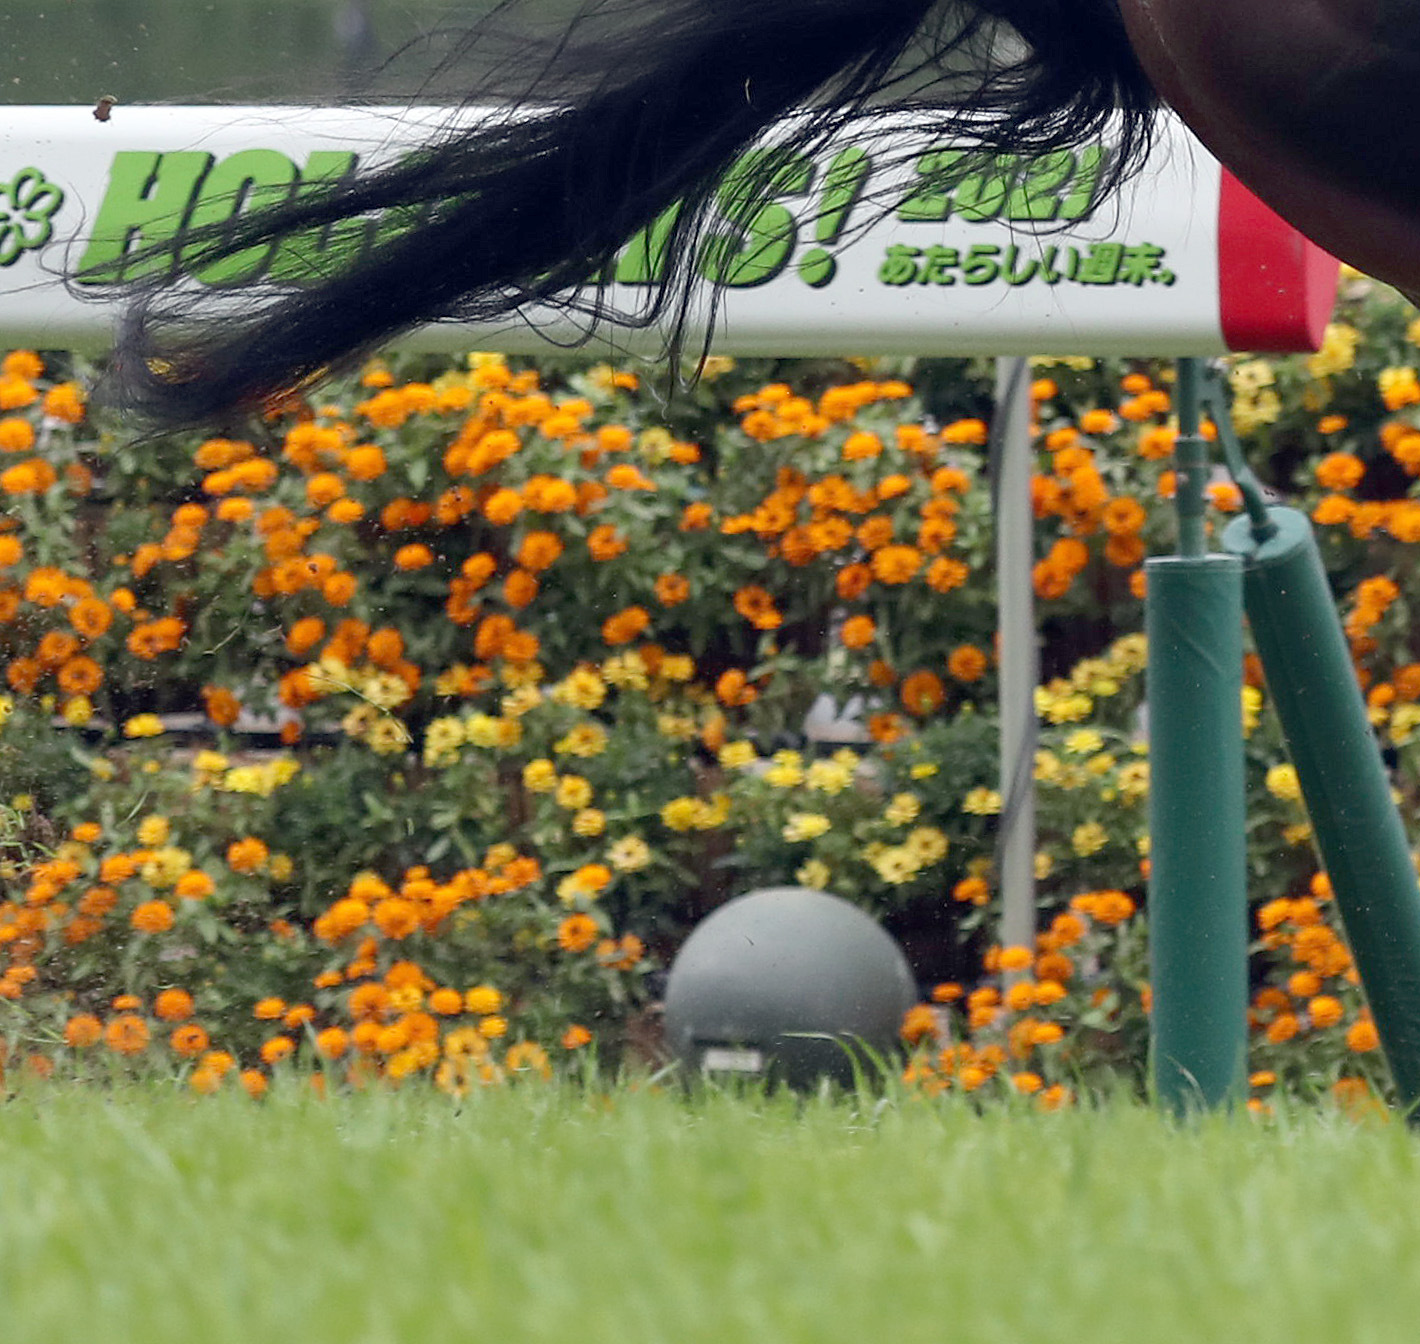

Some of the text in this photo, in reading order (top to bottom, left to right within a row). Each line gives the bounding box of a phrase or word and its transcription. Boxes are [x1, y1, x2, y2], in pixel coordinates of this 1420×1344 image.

[878, 242, 1174, 286] あたらしい週末。
